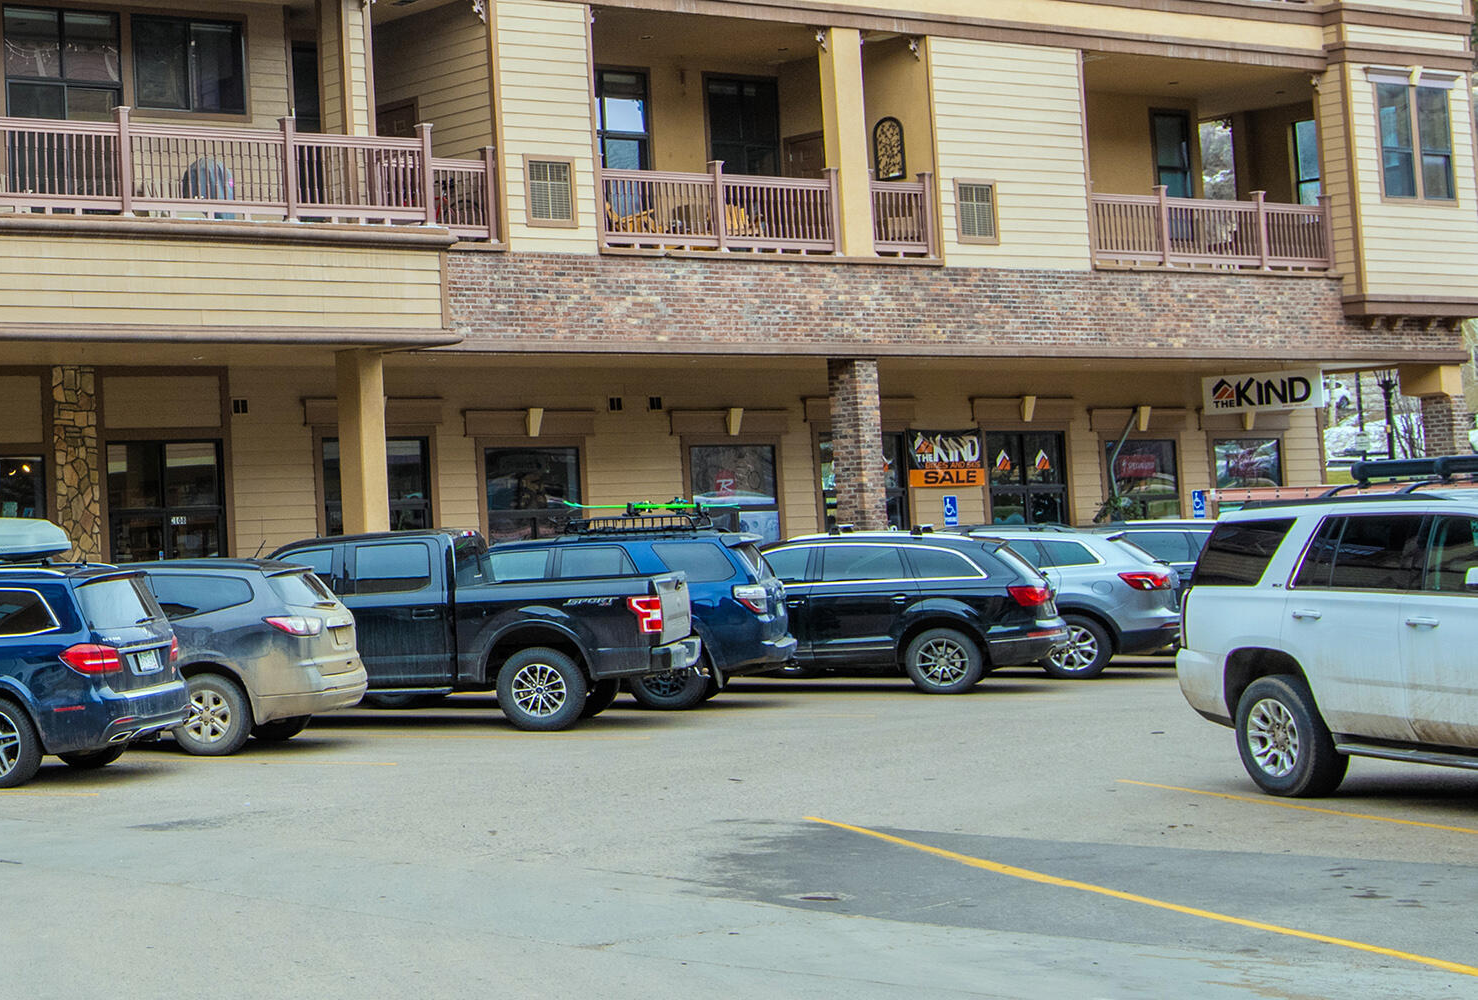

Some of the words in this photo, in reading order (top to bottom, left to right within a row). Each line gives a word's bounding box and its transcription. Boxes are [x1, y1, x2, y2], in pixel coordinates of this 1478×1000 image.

[1213, 399, 1235, 409] THE
[1235, 376, 1312, 407] KIND
[915, 453, 934, 462] THE
[933, 434, 980, 463] KIND
[924, 470, 977, 485] SALE
